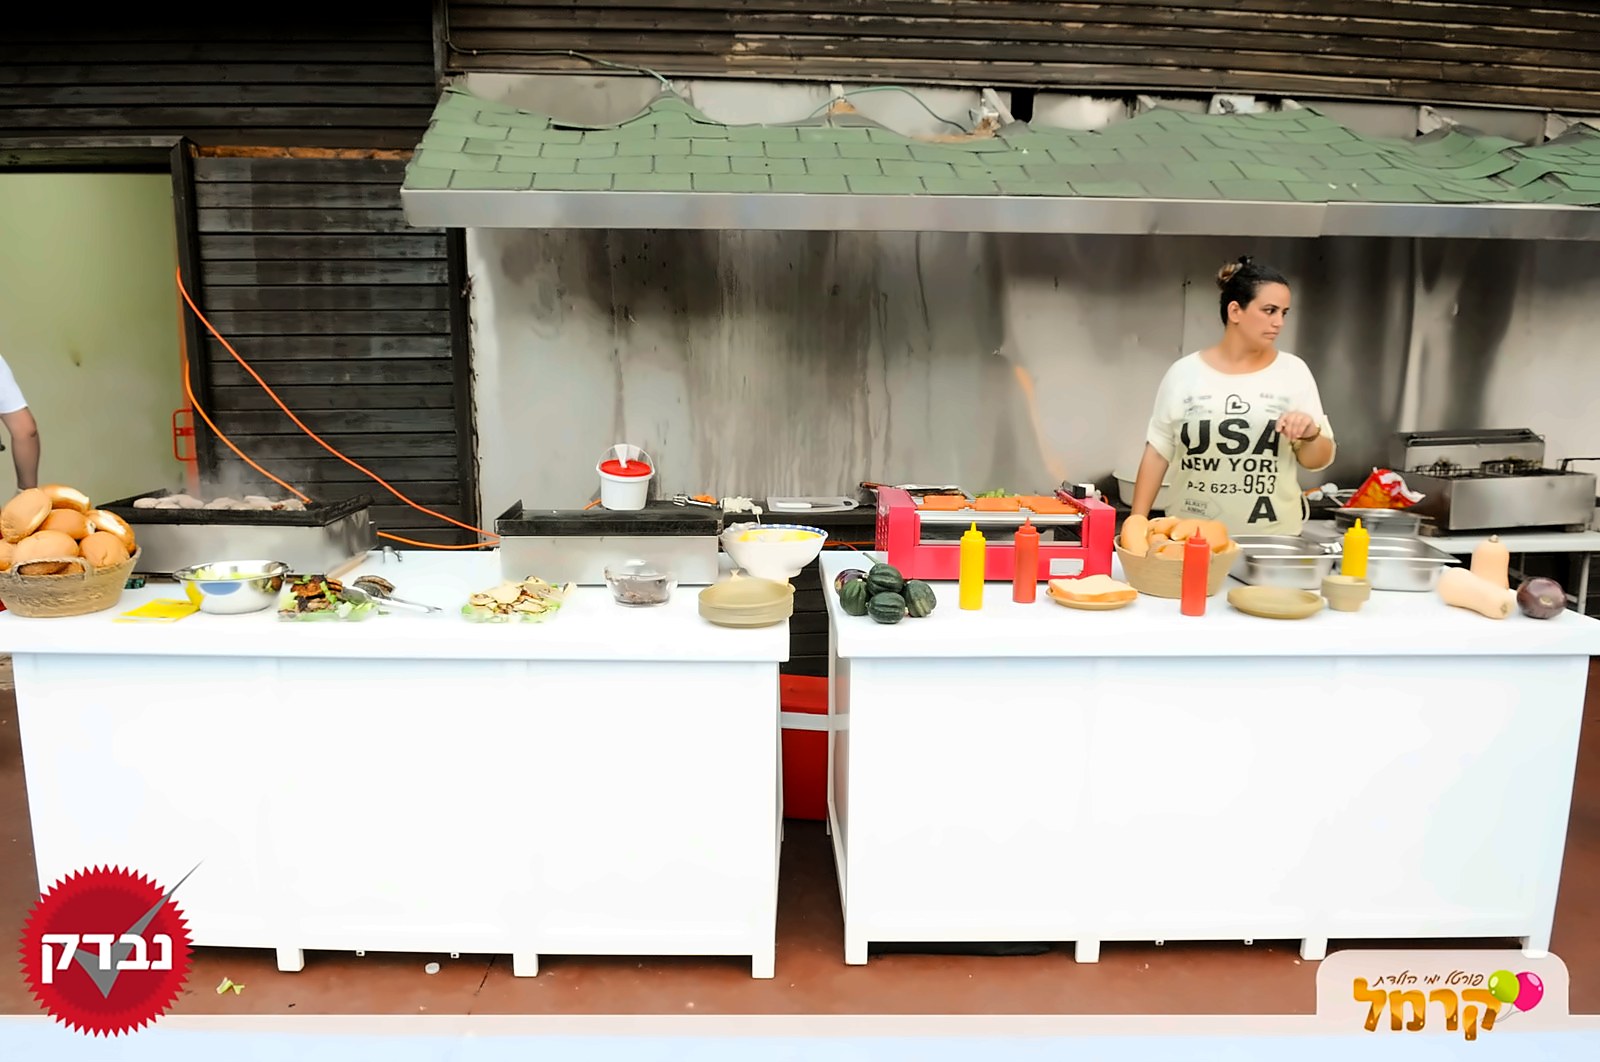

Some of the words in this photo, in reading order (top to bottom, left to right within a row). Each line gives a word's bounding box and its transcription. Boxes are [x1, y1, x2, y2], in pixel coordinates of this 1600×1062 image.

[1180, 418, 1281, 457] USA
[1181, 457, 1221, 471] NEW
[1210, 474, 1277, 494] 623-953
[1247, 496, 1278, 524] A
